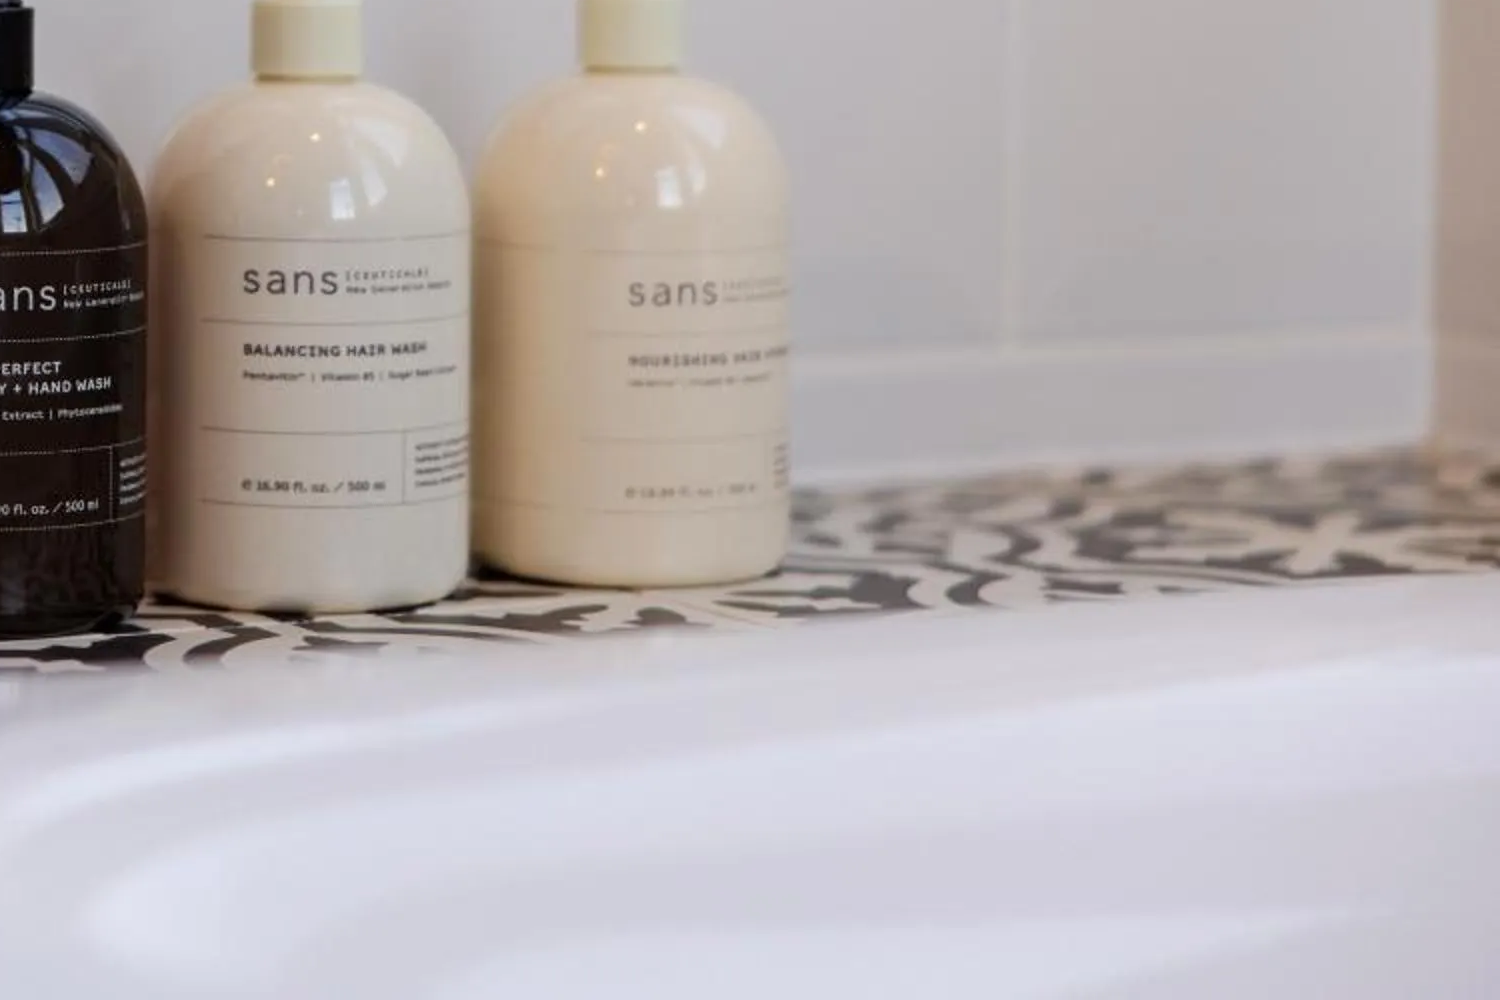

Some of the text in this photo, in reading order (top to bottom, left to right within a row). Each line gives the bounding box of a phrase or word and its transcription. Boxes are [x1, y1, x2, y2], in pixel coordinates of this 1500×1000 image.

[242, 268, 340, 295] sans
[627, 280, 719, 307] sans
[242, 340, 428, 358] BALANCING HAIR WASH
[28, 380, 72, 395] HAND
[76, 376, 112, 391] WASH
[2, 410, 45, 422] Extract
[31, 505, 50, 515] oz.
[65, 499, 85, 513] 500
[87, 498, 99, 511] ml
